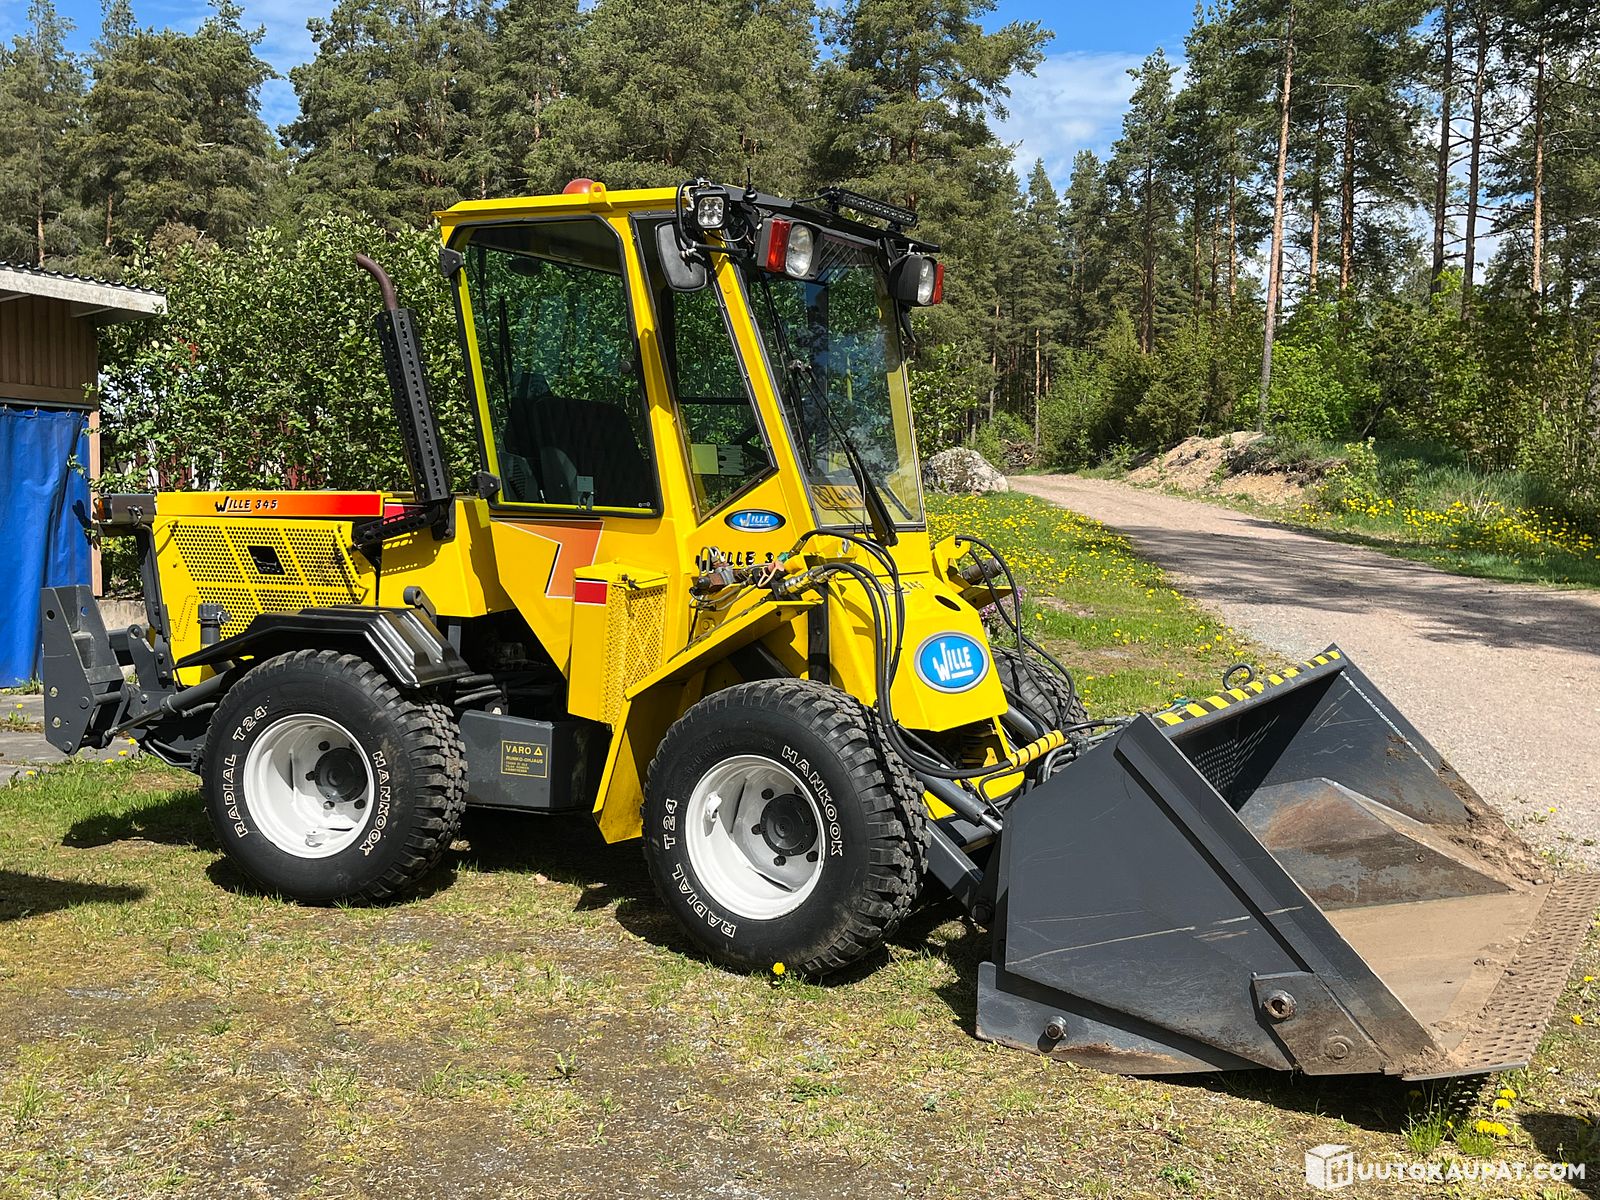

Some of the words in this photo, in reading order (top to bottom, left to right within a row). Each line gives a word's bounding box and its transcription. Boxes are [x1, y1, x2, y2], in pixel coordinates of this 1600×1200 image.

[214, 495, 252, 513] WILLE
[255, 499, 278, 510] 345
[739, 512, 771, 527] WILLE
[931, 641, 975, 682] WILLE
[232, 705, 267, 742] T24
[505, 744, 532, 755] VARO
[222, 753, 249, 838] RADIAL
[359, 750, 392, 856] HANKOOK
[781, 745, 843, 857] HANKOOK
[663, 798, 678, 850] T24
[672, 863, 737, 938] RADIAL
